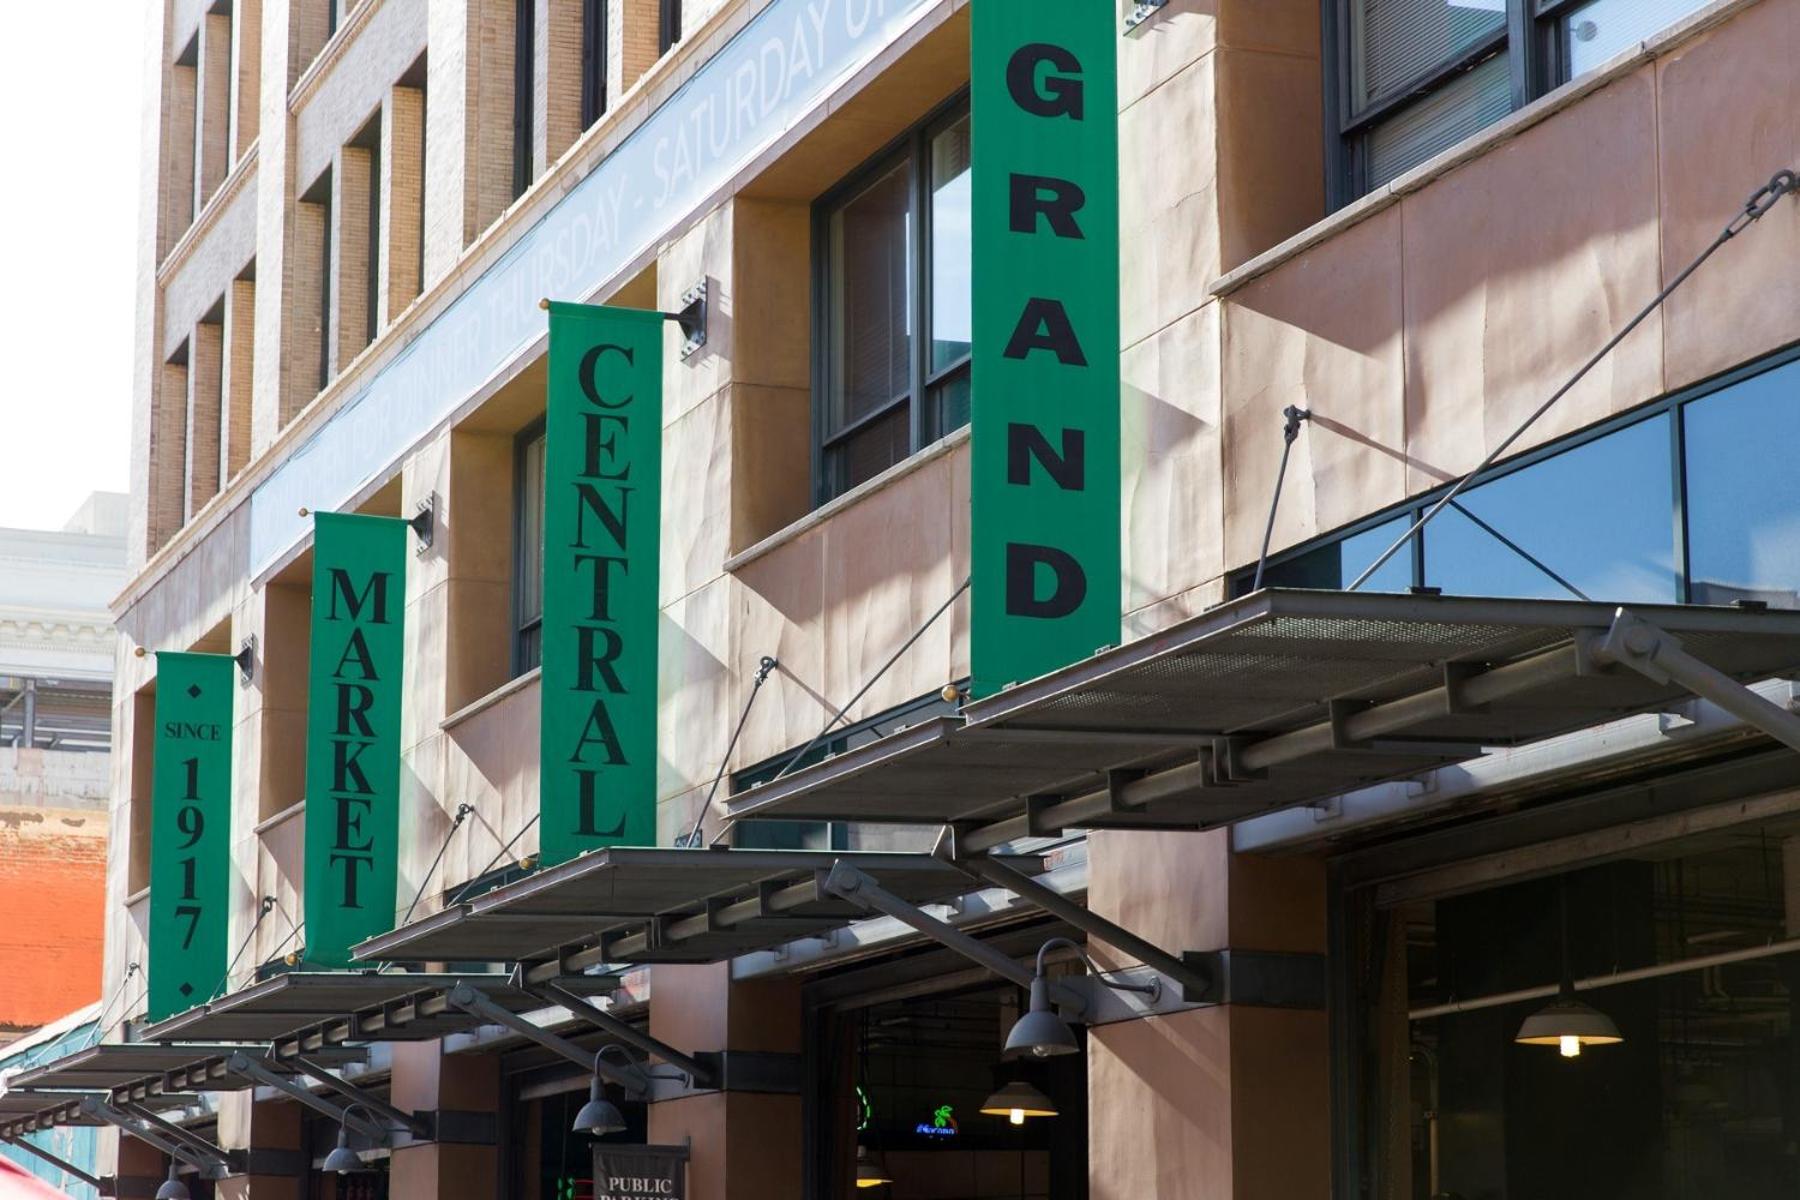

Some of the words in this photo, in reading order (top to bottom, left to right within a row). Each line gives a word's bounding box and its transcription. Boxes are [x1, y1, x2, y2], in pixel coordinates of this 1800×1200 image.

[397, 308, 480, 435] DINNER
[488, 175, 625, 354] THURSDAY
[653, 0, 830, 208] SATURDAY
[1002, 42, 1089, 619] GRAND
[165, 721, 222, 741] SINCE
[325, 567, 395, 909] MARKET
[569, 343, 637, 839] CENTRAL
[174, 757, 206, 950] 1917
[608, 1176, 673, 1194] PUBLIC
